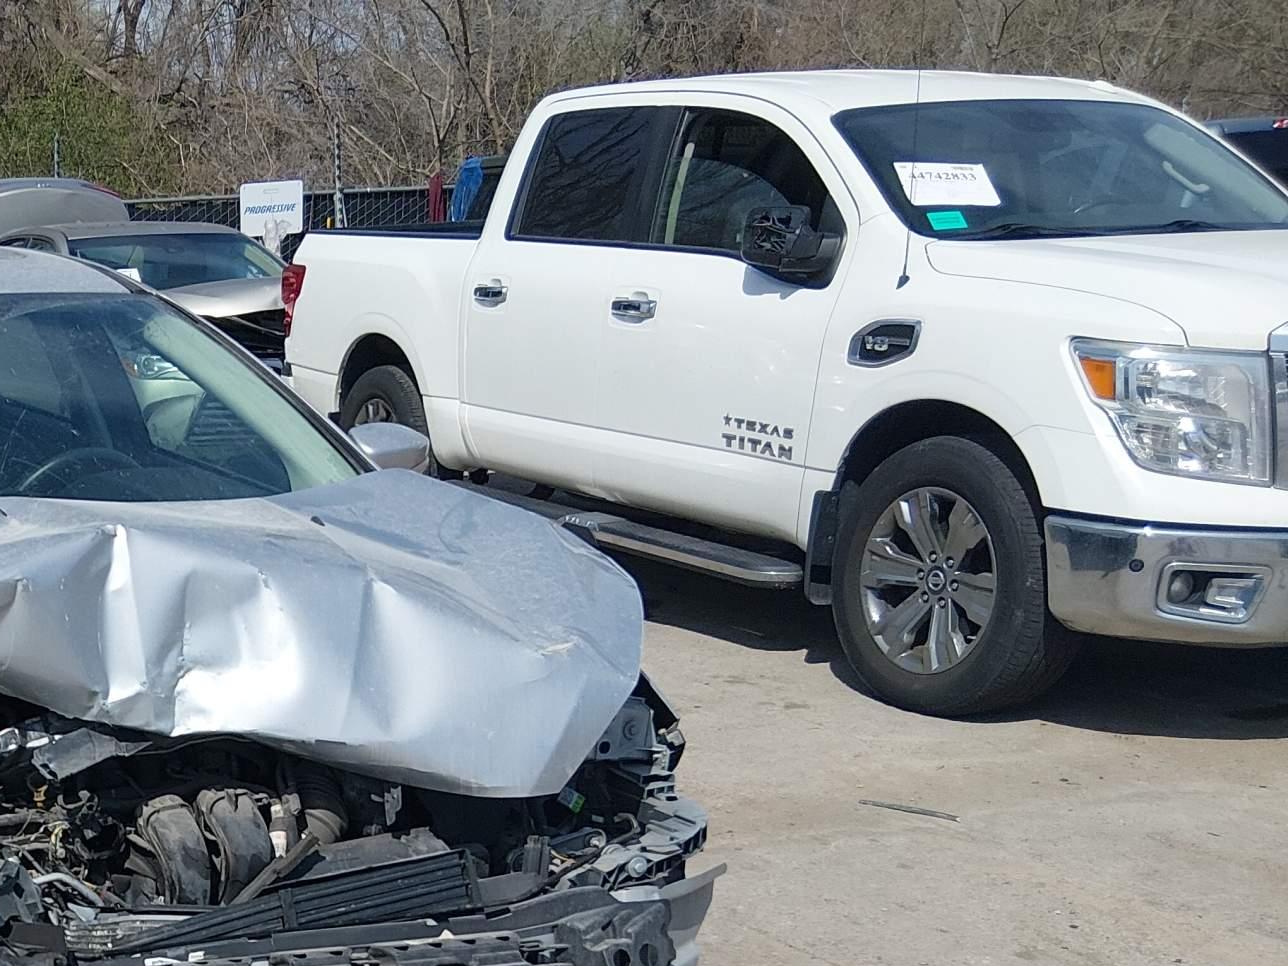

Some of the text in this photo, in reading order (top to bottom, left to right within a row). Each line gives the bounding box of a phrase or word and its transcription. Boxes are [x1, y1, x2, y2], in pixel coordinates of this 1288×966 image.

[908, 171, 977, 181] 44742833
[244, 202, 297, 216] PROGRESSIVE
[733, 417, 794, 440] TEXAS
[721, 432, 793, 461] TITAN
